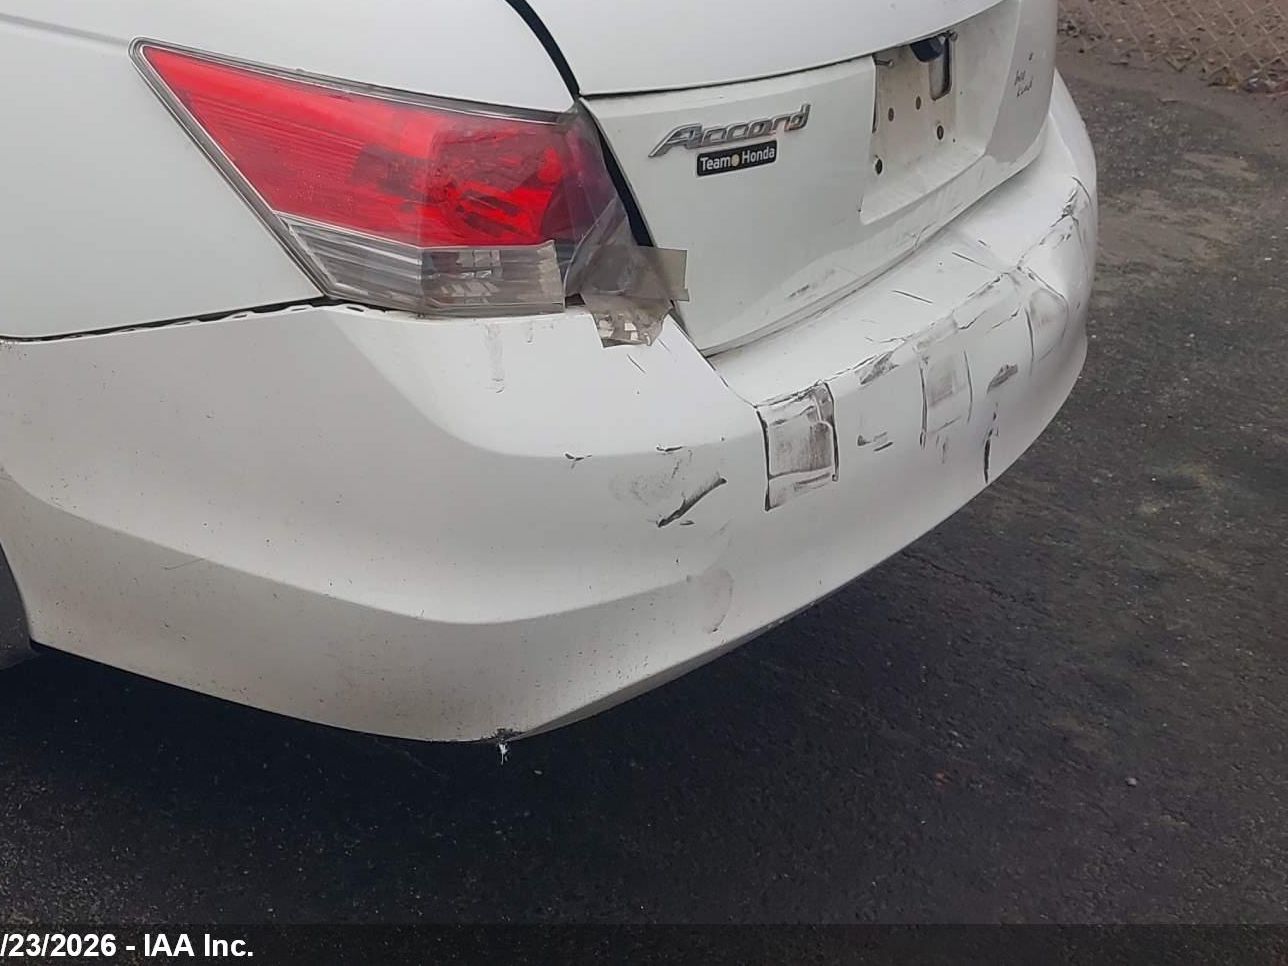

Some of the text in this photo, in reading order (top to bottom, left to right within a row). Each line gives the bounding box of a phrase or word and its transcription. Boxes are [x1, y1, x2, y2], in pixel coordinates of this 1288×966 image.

[648, 103, 811, 157] Accord
[700, 146, 775, 171] Team Honda
